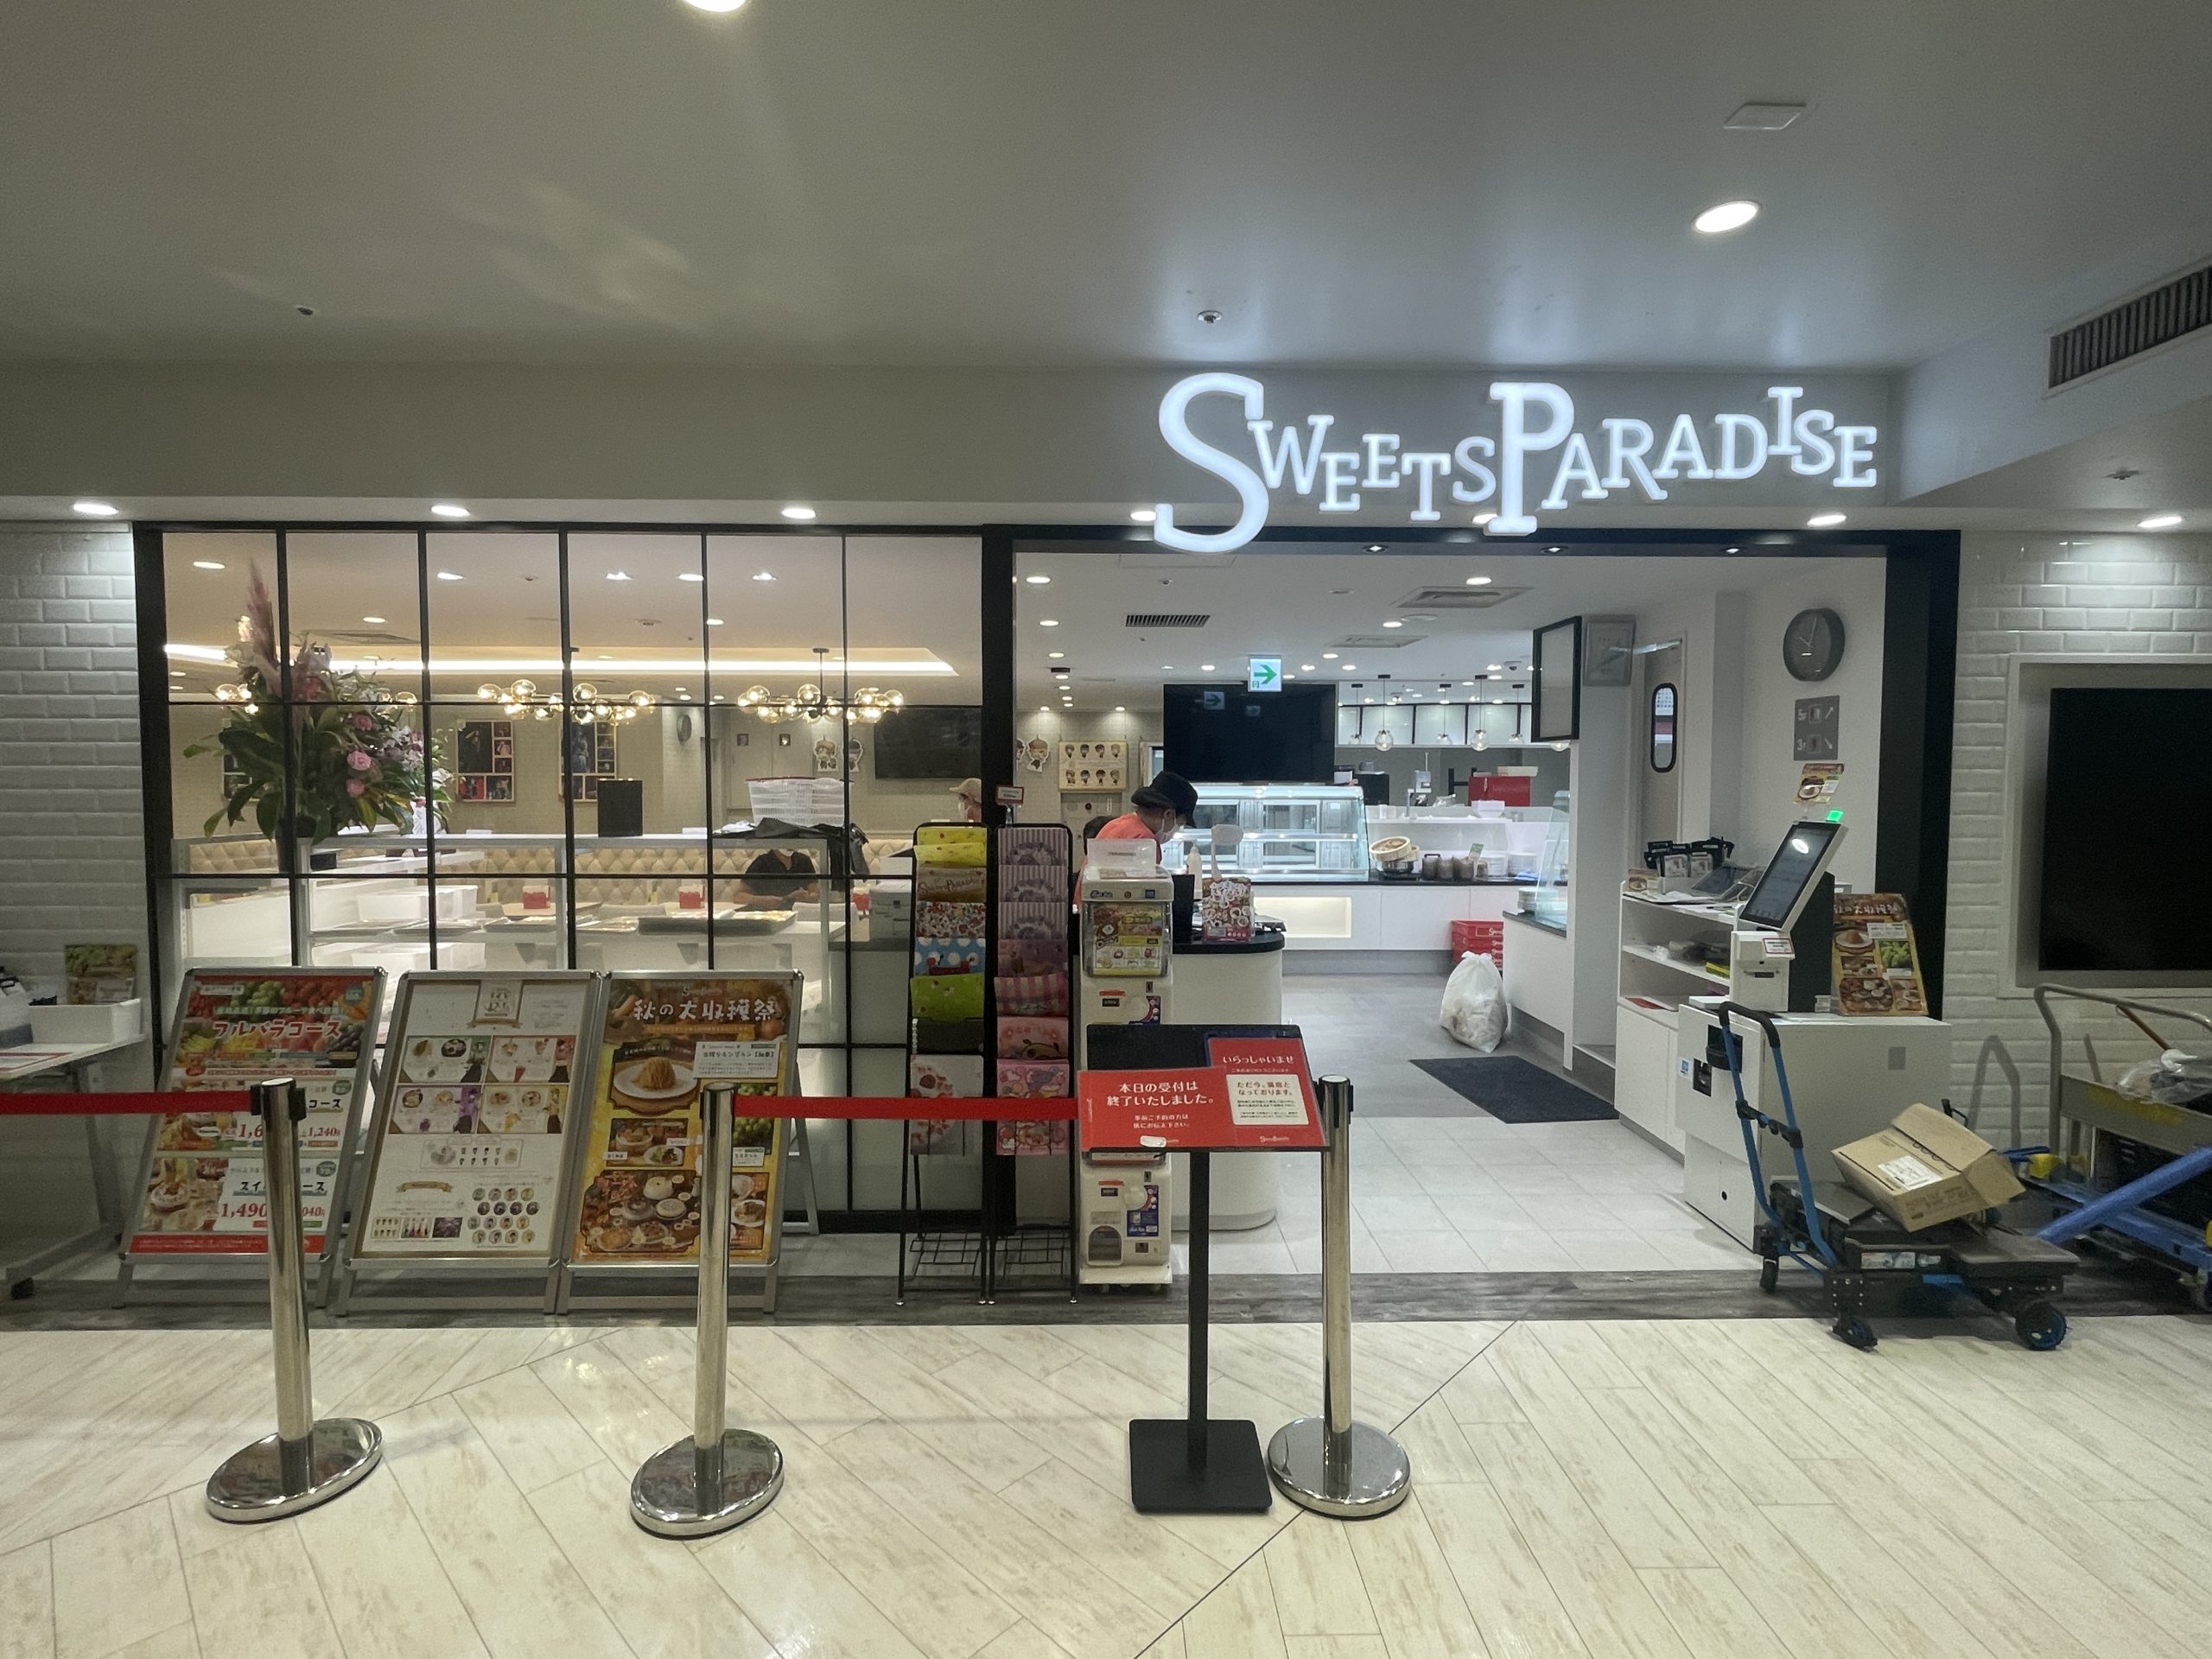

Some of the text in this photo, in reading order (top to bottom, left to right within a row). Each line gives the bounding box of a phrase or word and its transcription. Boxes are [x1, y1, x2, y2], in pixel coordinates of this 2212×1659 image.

[633, 999, 776, 1020] 秋の大収穫祭
[213, 1020, 342, 1039] フルパラコース
[1223, 1055, 1294, 1065] いらっしゃいませ
[1119, 1080, 1198, 1094] 本日の受付は
[1107, 1093, 1214, 1107] 終了いたしました。
